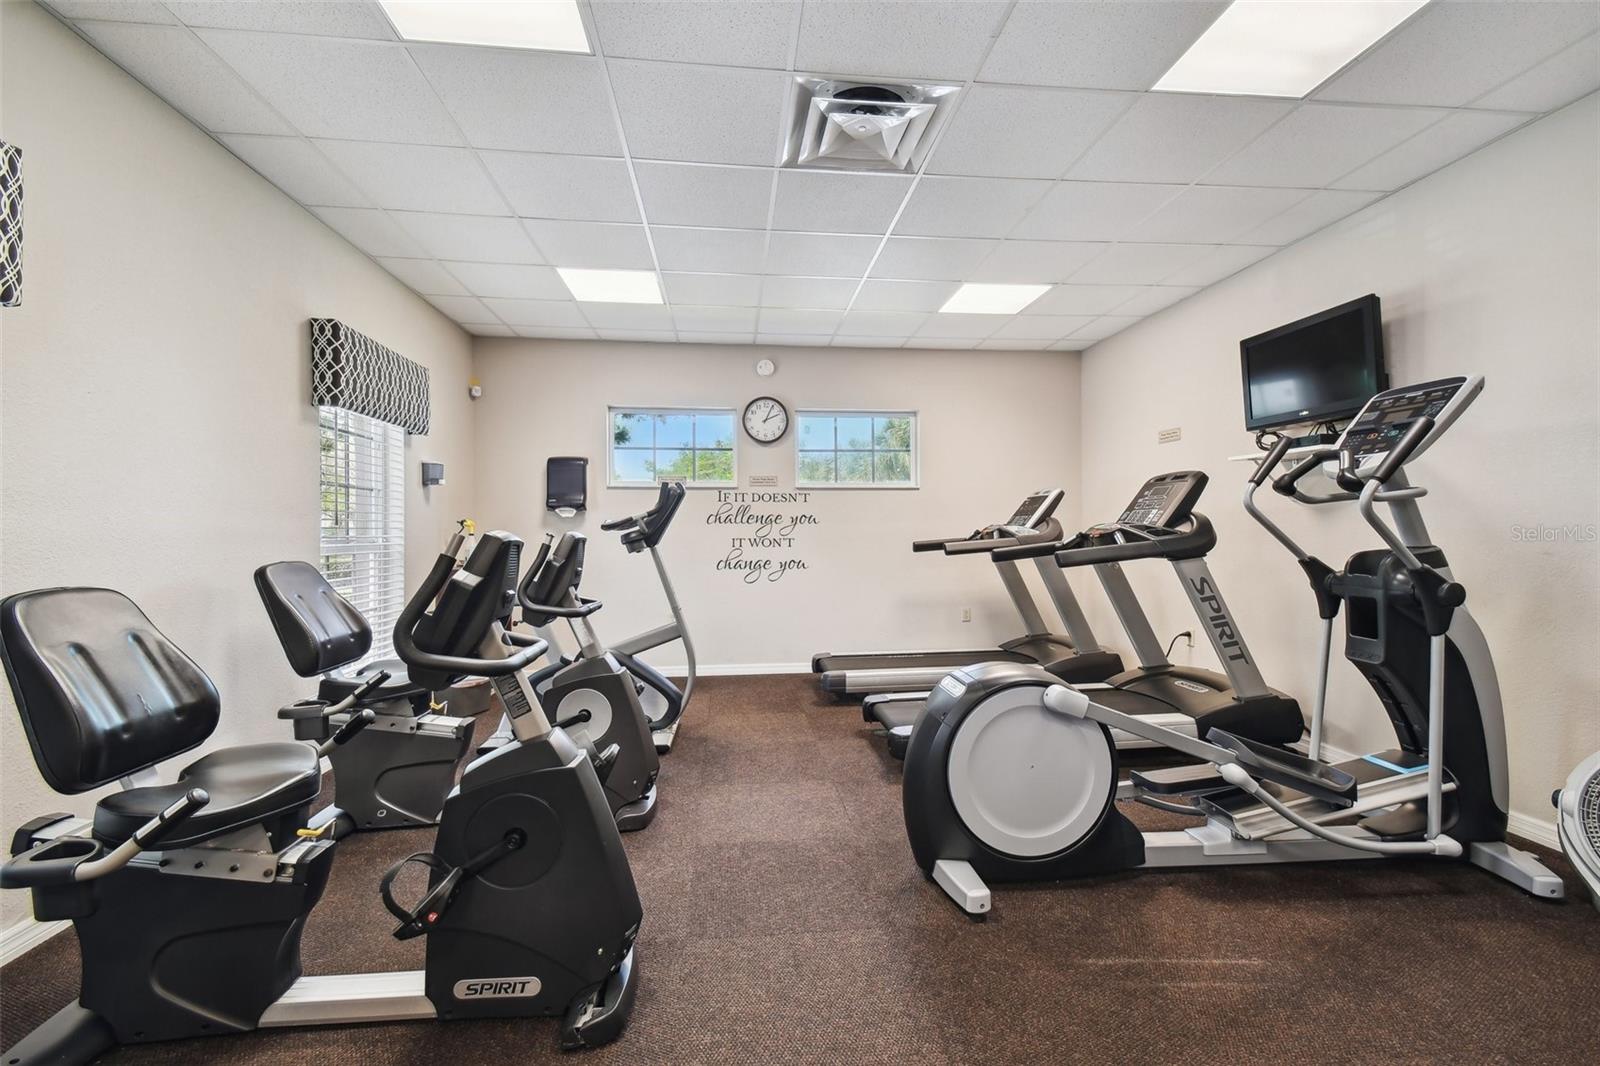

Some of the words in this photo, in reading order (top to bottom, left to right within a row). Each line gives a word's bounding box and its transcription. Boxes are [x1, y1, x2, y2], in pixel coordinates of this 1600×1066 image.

[735, 493, 748, 502] IT
[752, 492, 811, 503] DOESN'T
[706, 502, 783, 538] challenge
[779, 514, 820, 537] you
[731, 538, 746, 548] IT
[748, 537, 795, 548] WON'T
[716, 548, 772, 584] change
[767, 560, 809, 582] you
[1190, 576, 1249, 665] SPIRIT
[464, 981, 531, 996] SPIRIT
